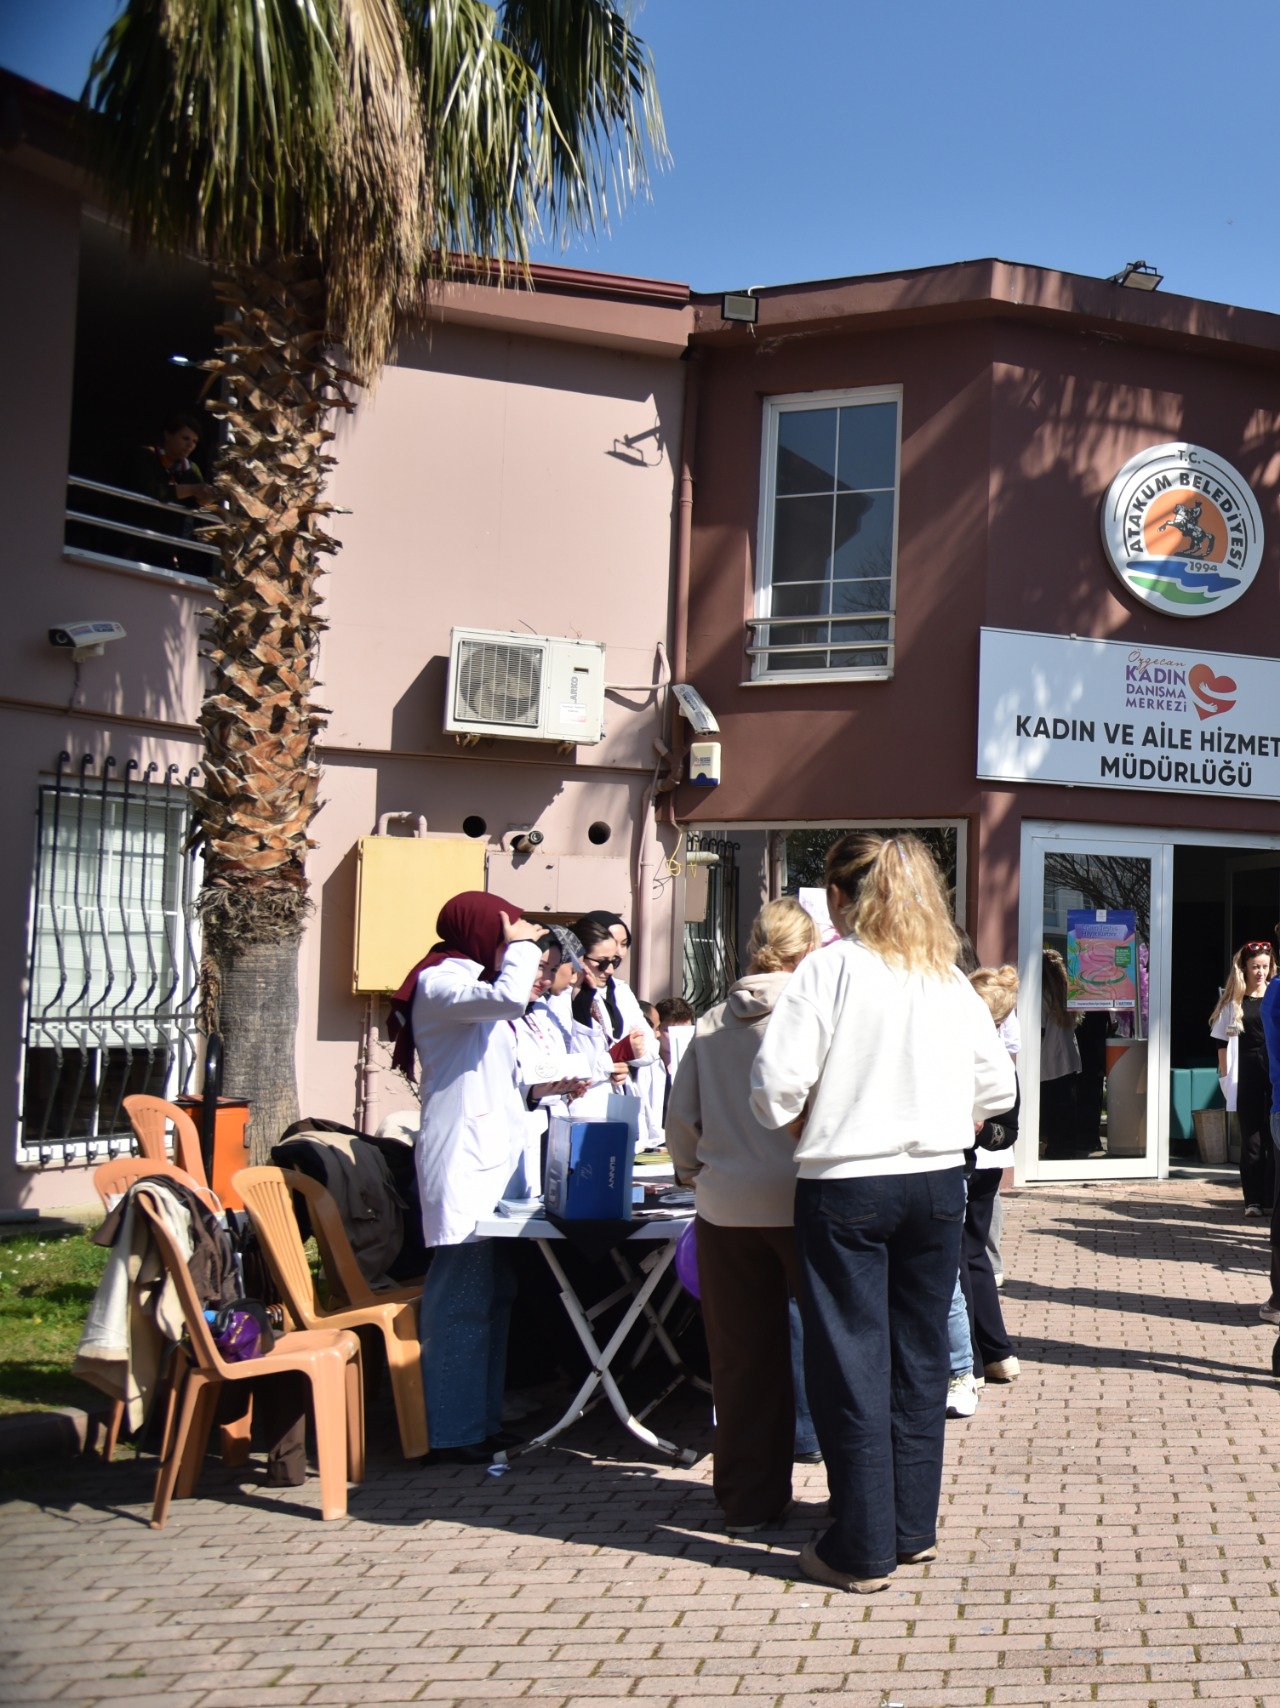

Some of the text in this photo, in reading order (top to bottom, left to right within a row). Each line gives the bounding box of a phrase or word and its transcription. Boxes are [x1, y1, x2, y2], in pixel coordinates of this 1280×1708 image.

[1178, 450, 1201, 464] T.C.
[1127, 472, 1244, 571] ATAKUM BELEDİYESİ
[1189, 561, 1218, 572] 1994
[1125, 665, 1187, 686] KADIN
[1126, 683, 1187, 699] DANIŞMA
[1016, 714, 1095, 743] KADIN
[1103, 722, 1135, 745] VE
[1141, 721, 1193, 750] AİLE
[1100, 752, 1252, 787] MÜDÜRLÜĞÜ
[608, 1155, 616, 1189] SUNNY
